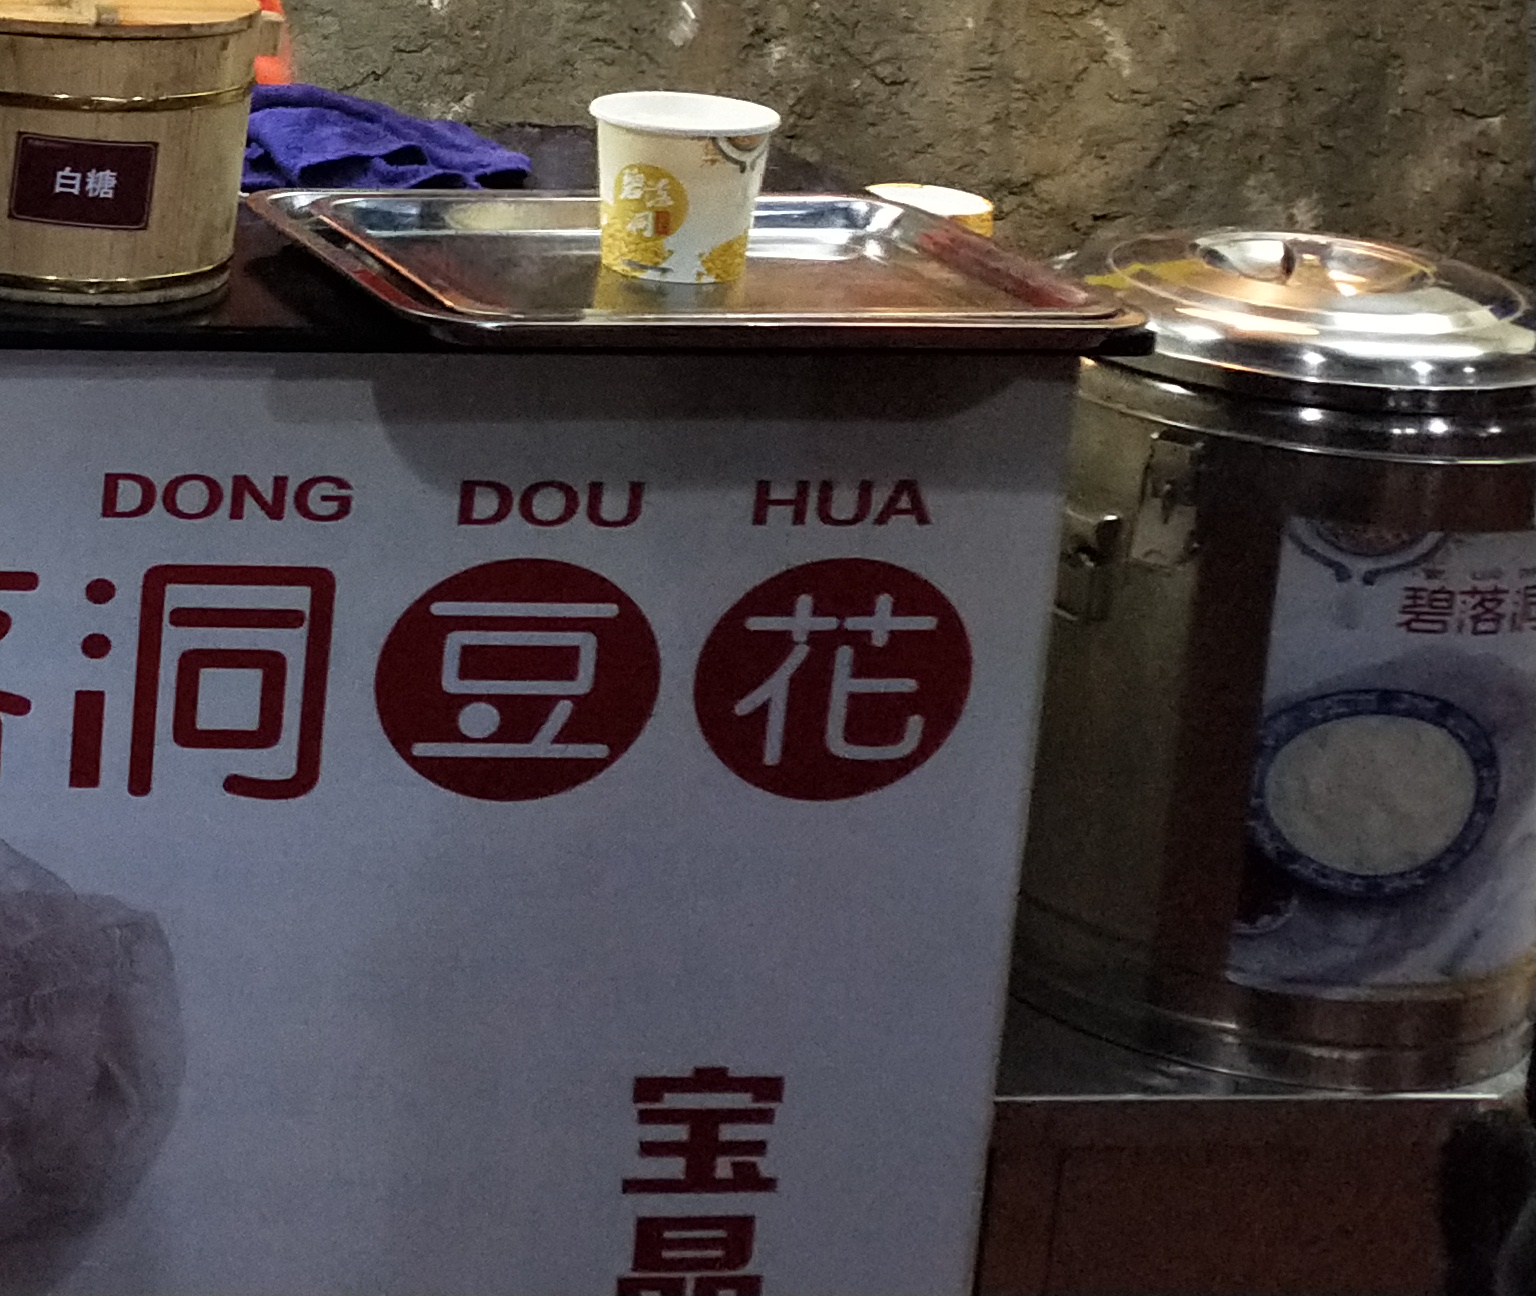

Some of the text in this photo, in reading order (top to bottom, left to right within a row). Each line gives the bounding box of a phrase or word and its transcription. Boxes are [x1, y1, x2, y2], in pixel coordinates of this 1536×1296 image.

[54, 166, 118, 199] 白糖
[101, 471, 355, 522] DONG
[456, 478, 646, 528] DOU
[750, 479, 934, 527] HUA
